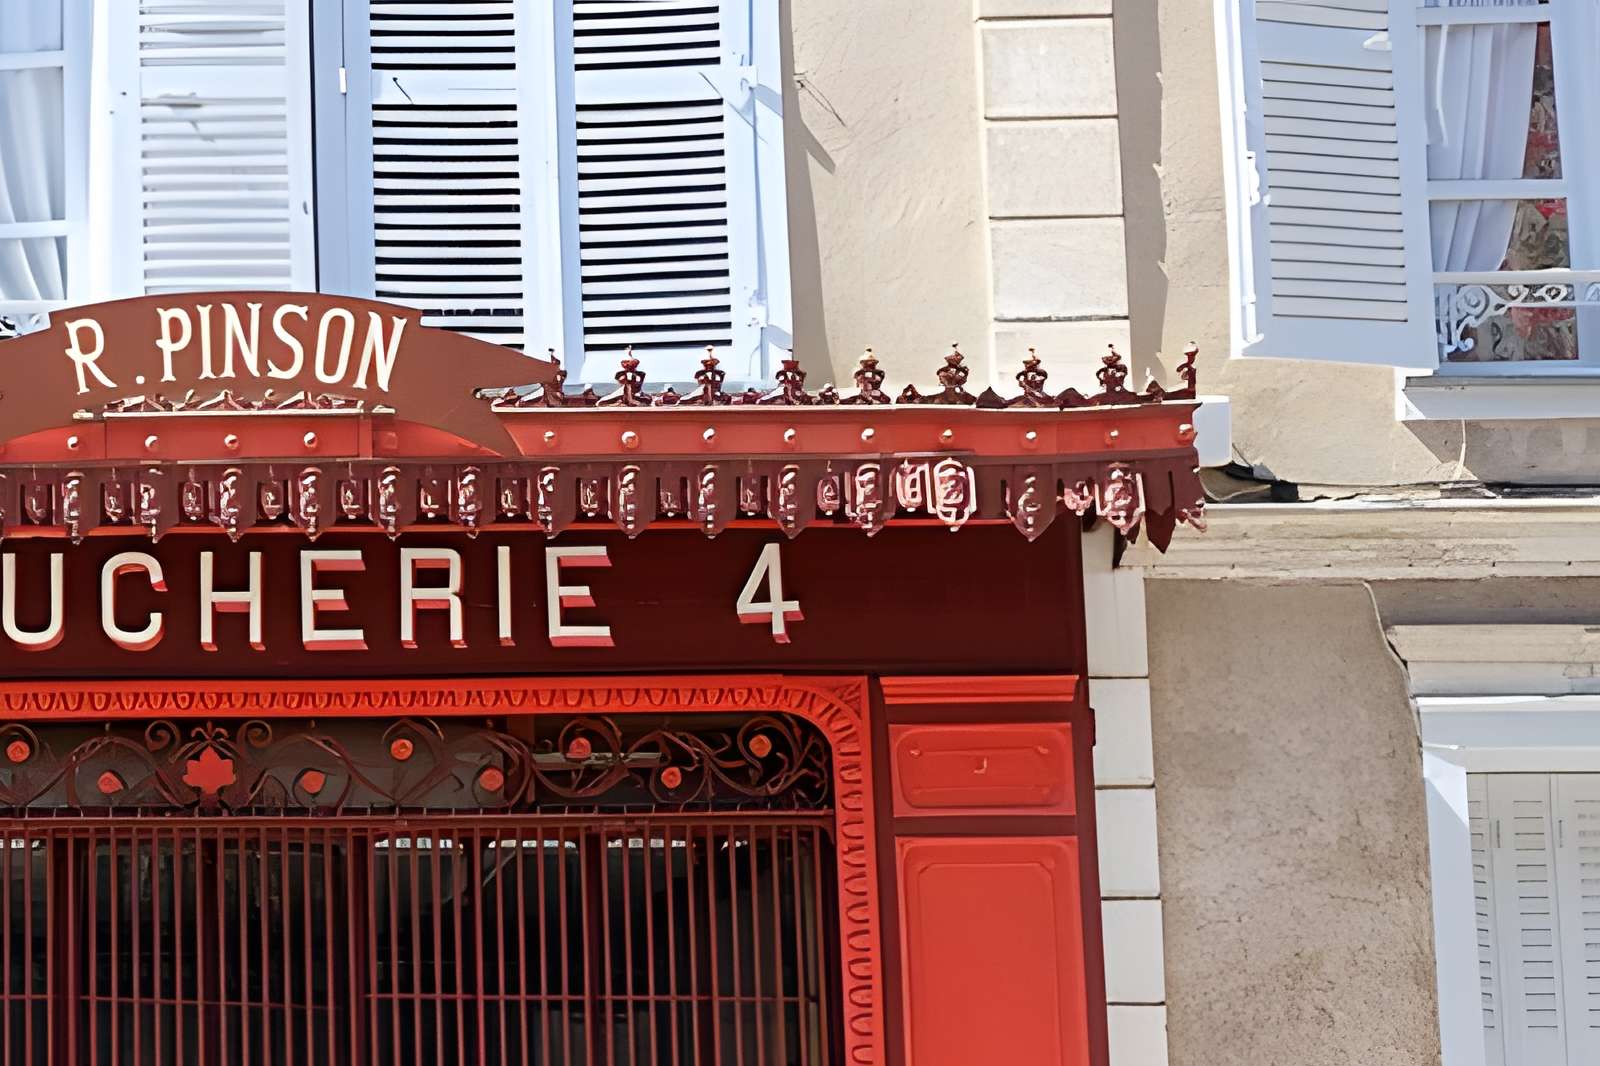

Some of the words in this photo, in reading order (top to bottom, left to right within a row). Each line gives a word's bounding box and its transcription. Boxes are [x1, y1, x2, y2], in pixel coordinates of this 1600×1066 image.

[64, 317, 146, 396] R.
[155, 302, 408, 393] PINSON
[736, 542, 804, 644] 4
